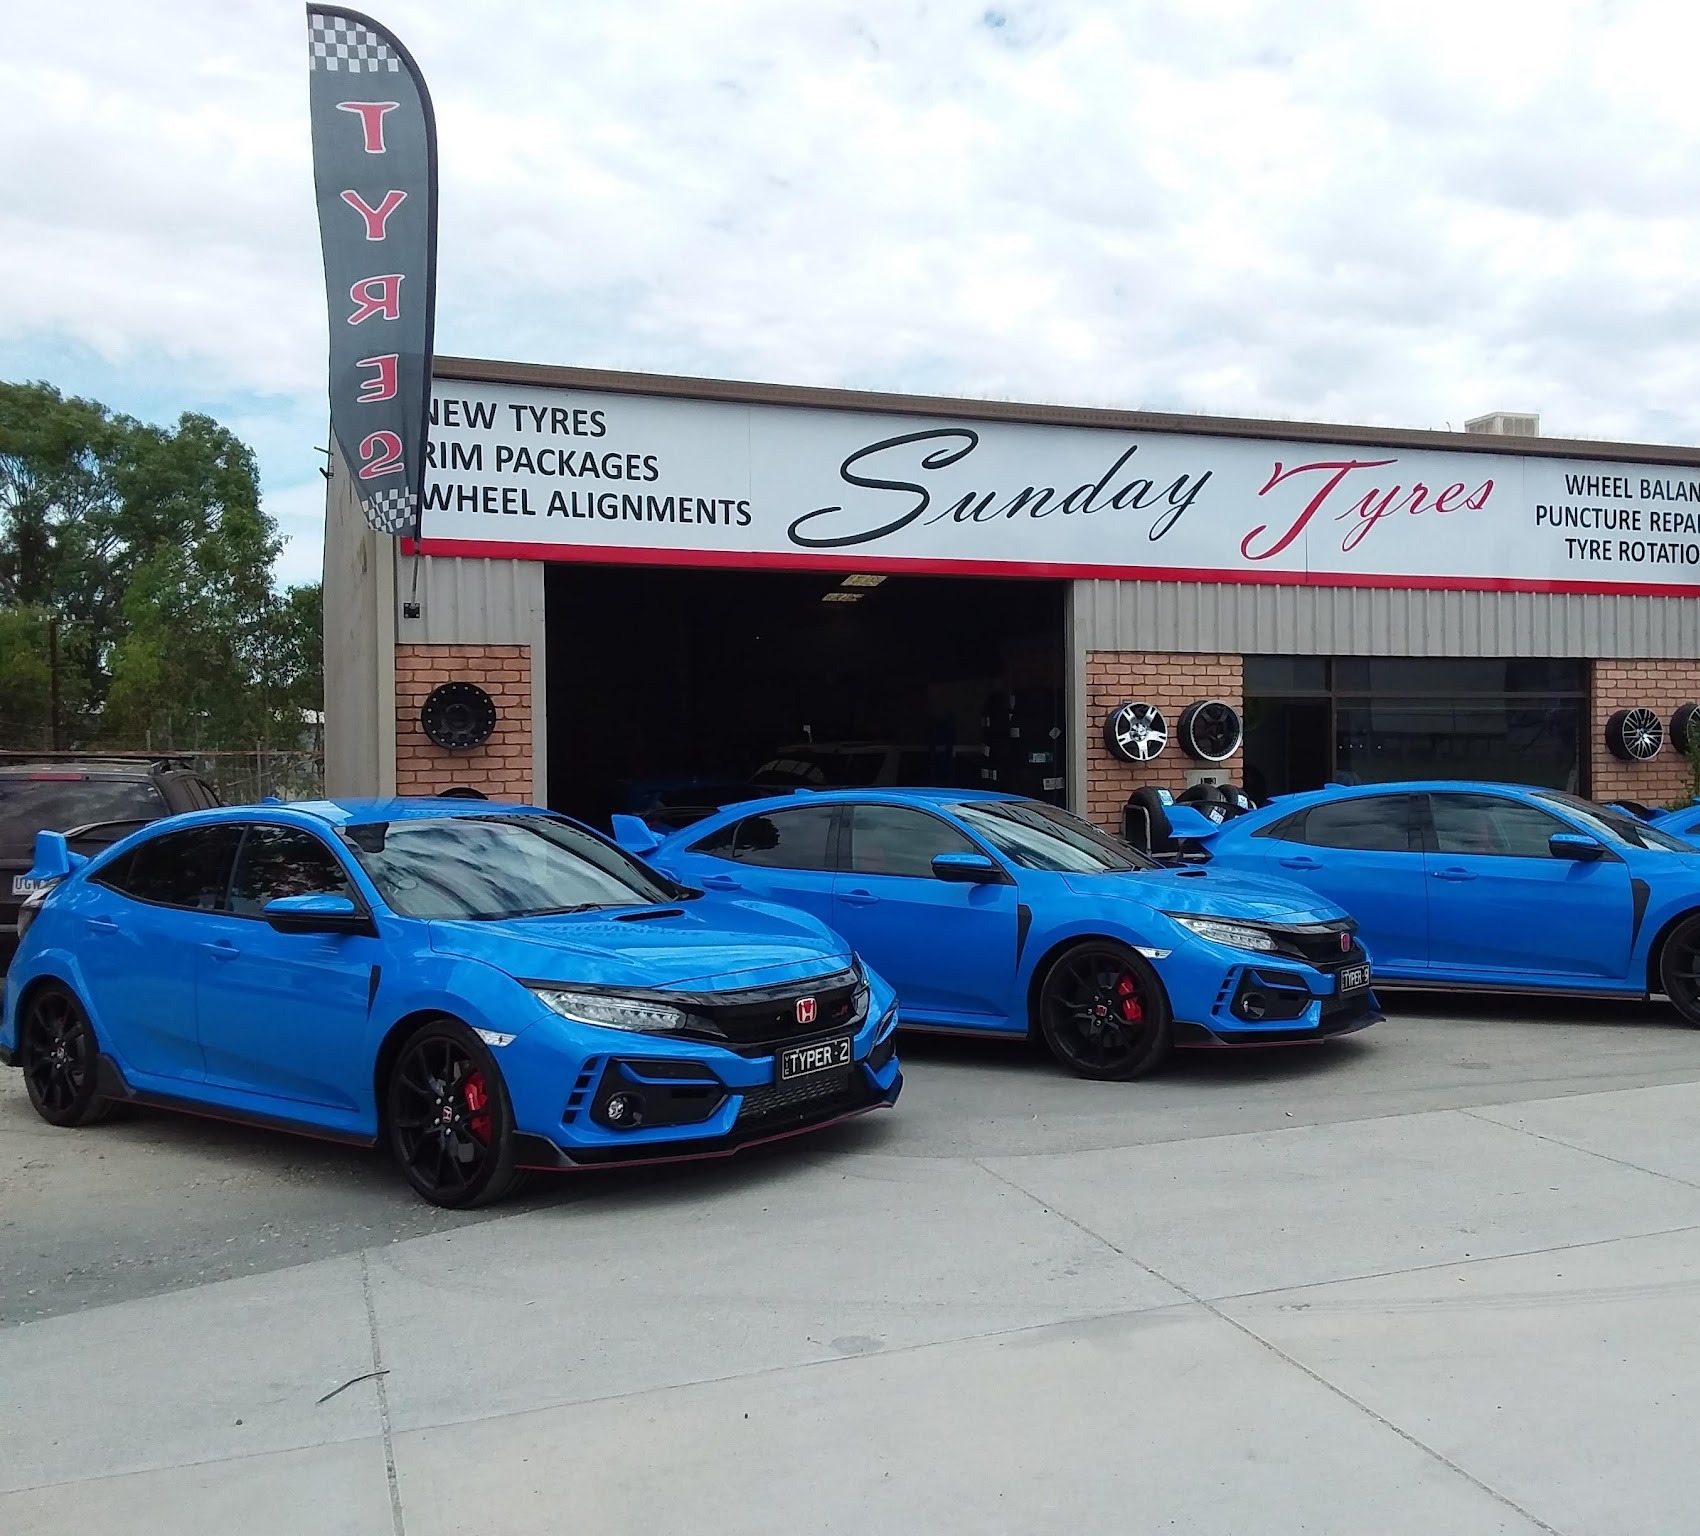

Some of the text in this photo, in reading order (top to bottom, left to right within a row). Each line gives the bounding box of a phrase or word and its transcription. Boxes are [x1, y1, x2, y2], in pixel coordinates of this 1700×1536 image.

[509, 404, 607, 437] TYRES
[496, 445, 659, 482] PACKAGES
[788, 428, 1494, 561] Sunday Tyres
[1565, 474, 1633, 499] WHEEL
[423, 484, 752, 526] WHEEL ALIGNMENTS
[1536, 505, 1641, 531] PUNCTURE
[1565, 538, 1700, 565] TYRE ROTATIO
